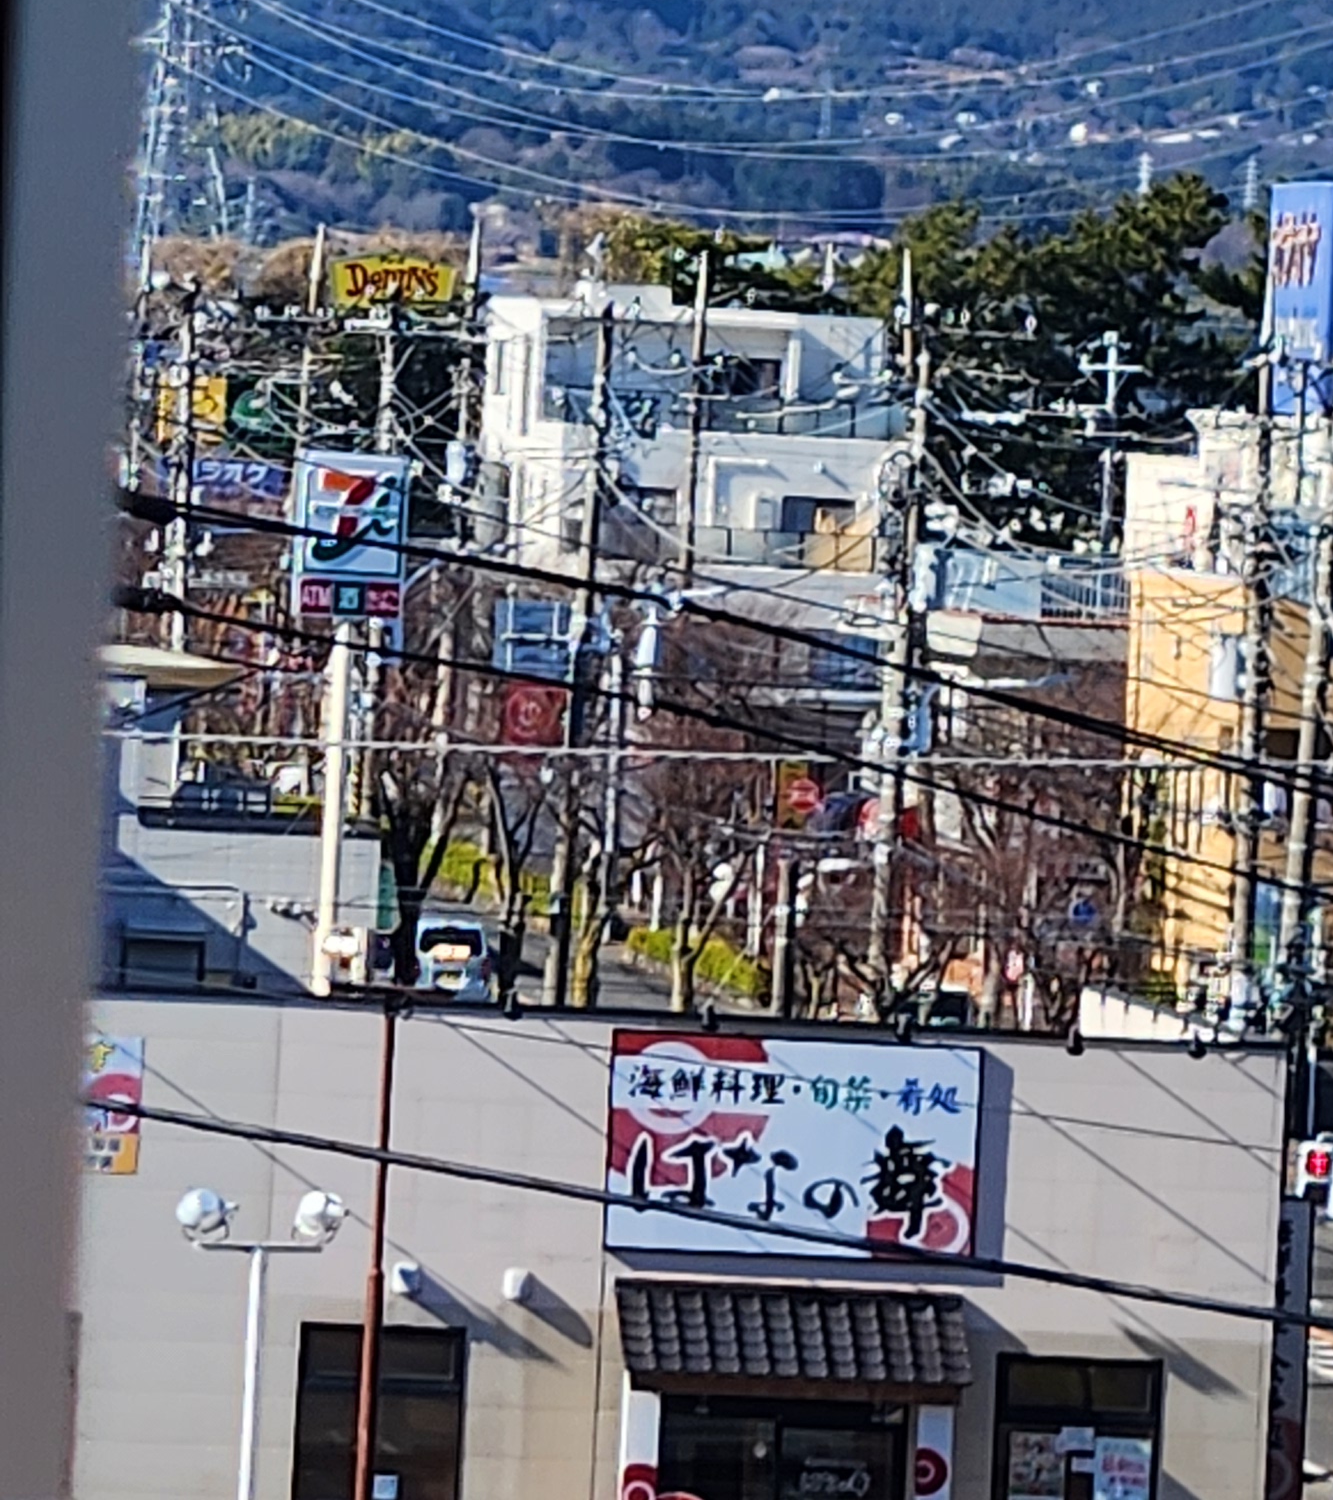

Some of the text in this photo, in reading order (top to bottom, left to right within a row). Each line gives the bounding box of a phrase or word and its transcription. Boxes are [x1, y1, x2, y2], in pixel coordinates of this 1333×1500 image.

[303, 584, 331, 607] ATM
[627, 1124, 952, 1240] はなの舞
